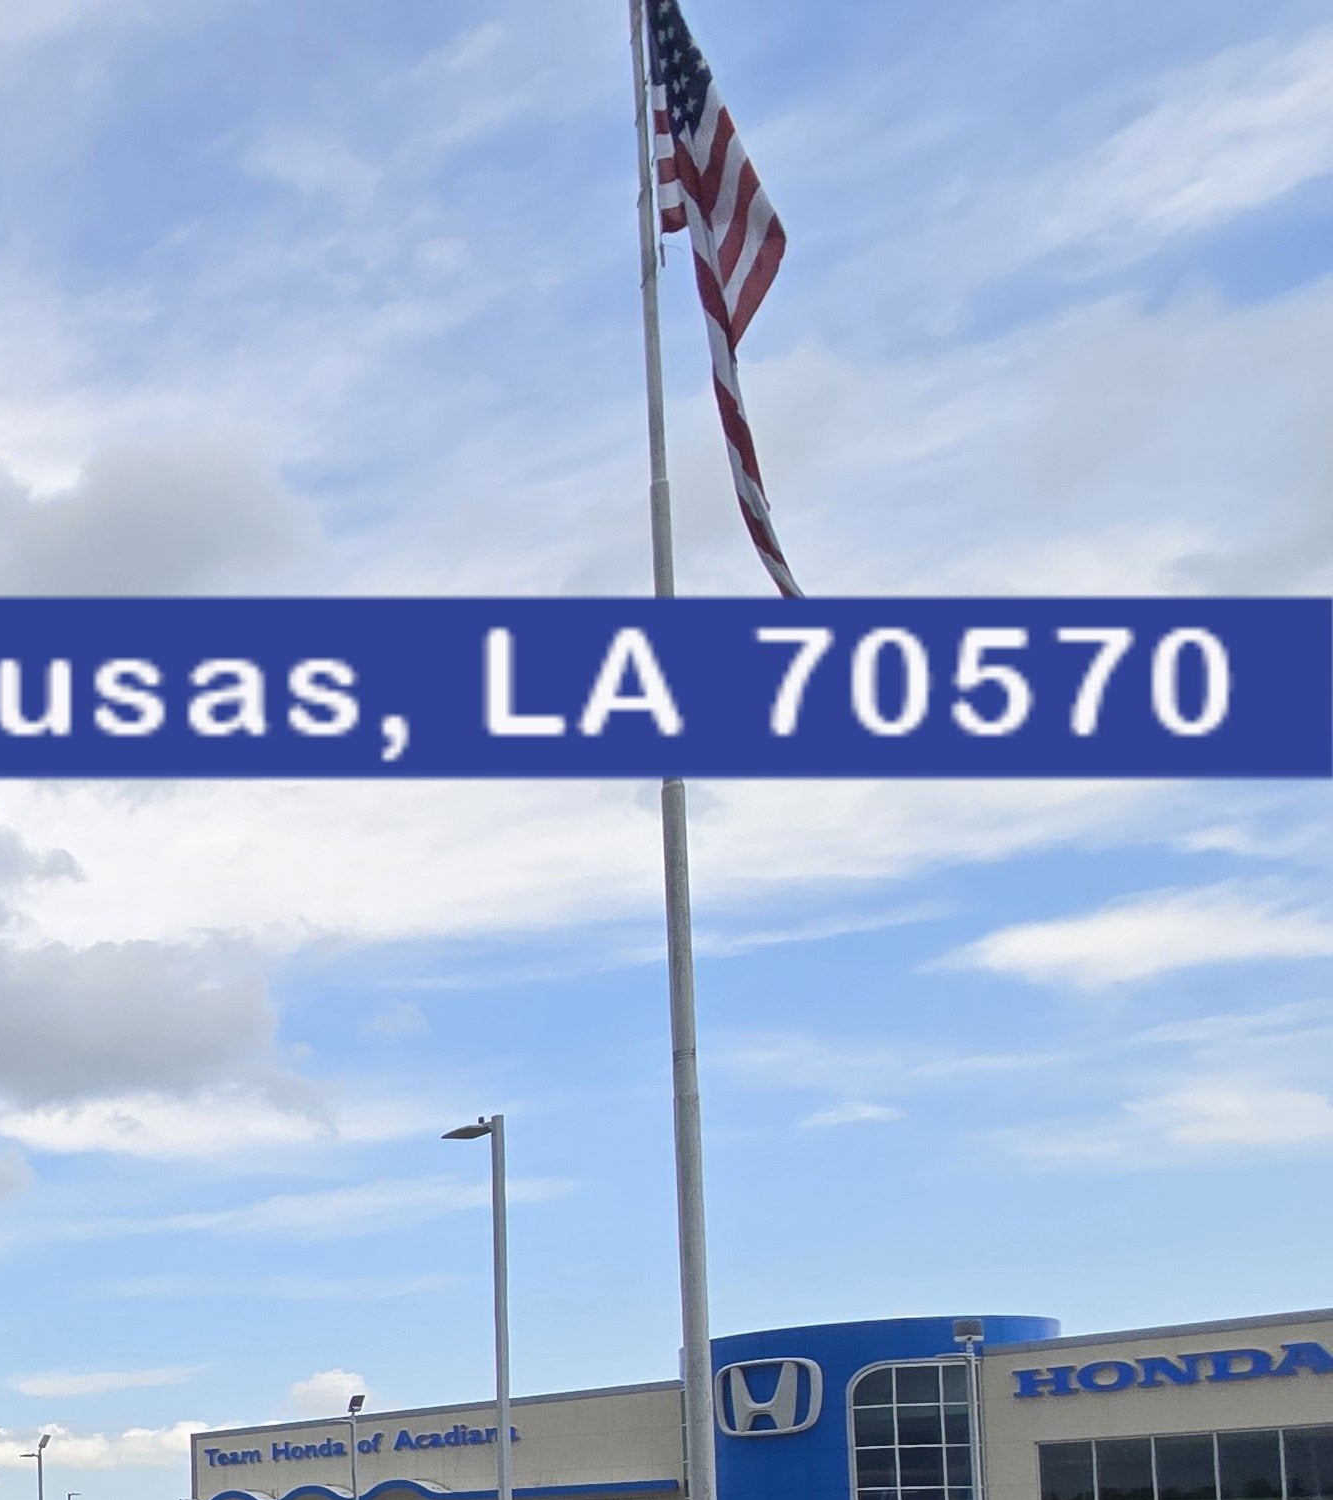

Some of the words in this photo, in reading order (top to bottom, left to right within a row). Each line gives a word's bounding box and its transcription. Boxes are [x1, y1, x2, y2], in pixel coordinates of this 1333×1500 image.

[1012, 1342, 1333, 1398] HONDA
[204, 1449, 262, 1466] Team
[272, 1438, 347, 1461] Honda
[357, 1433, 383, 1454] of
